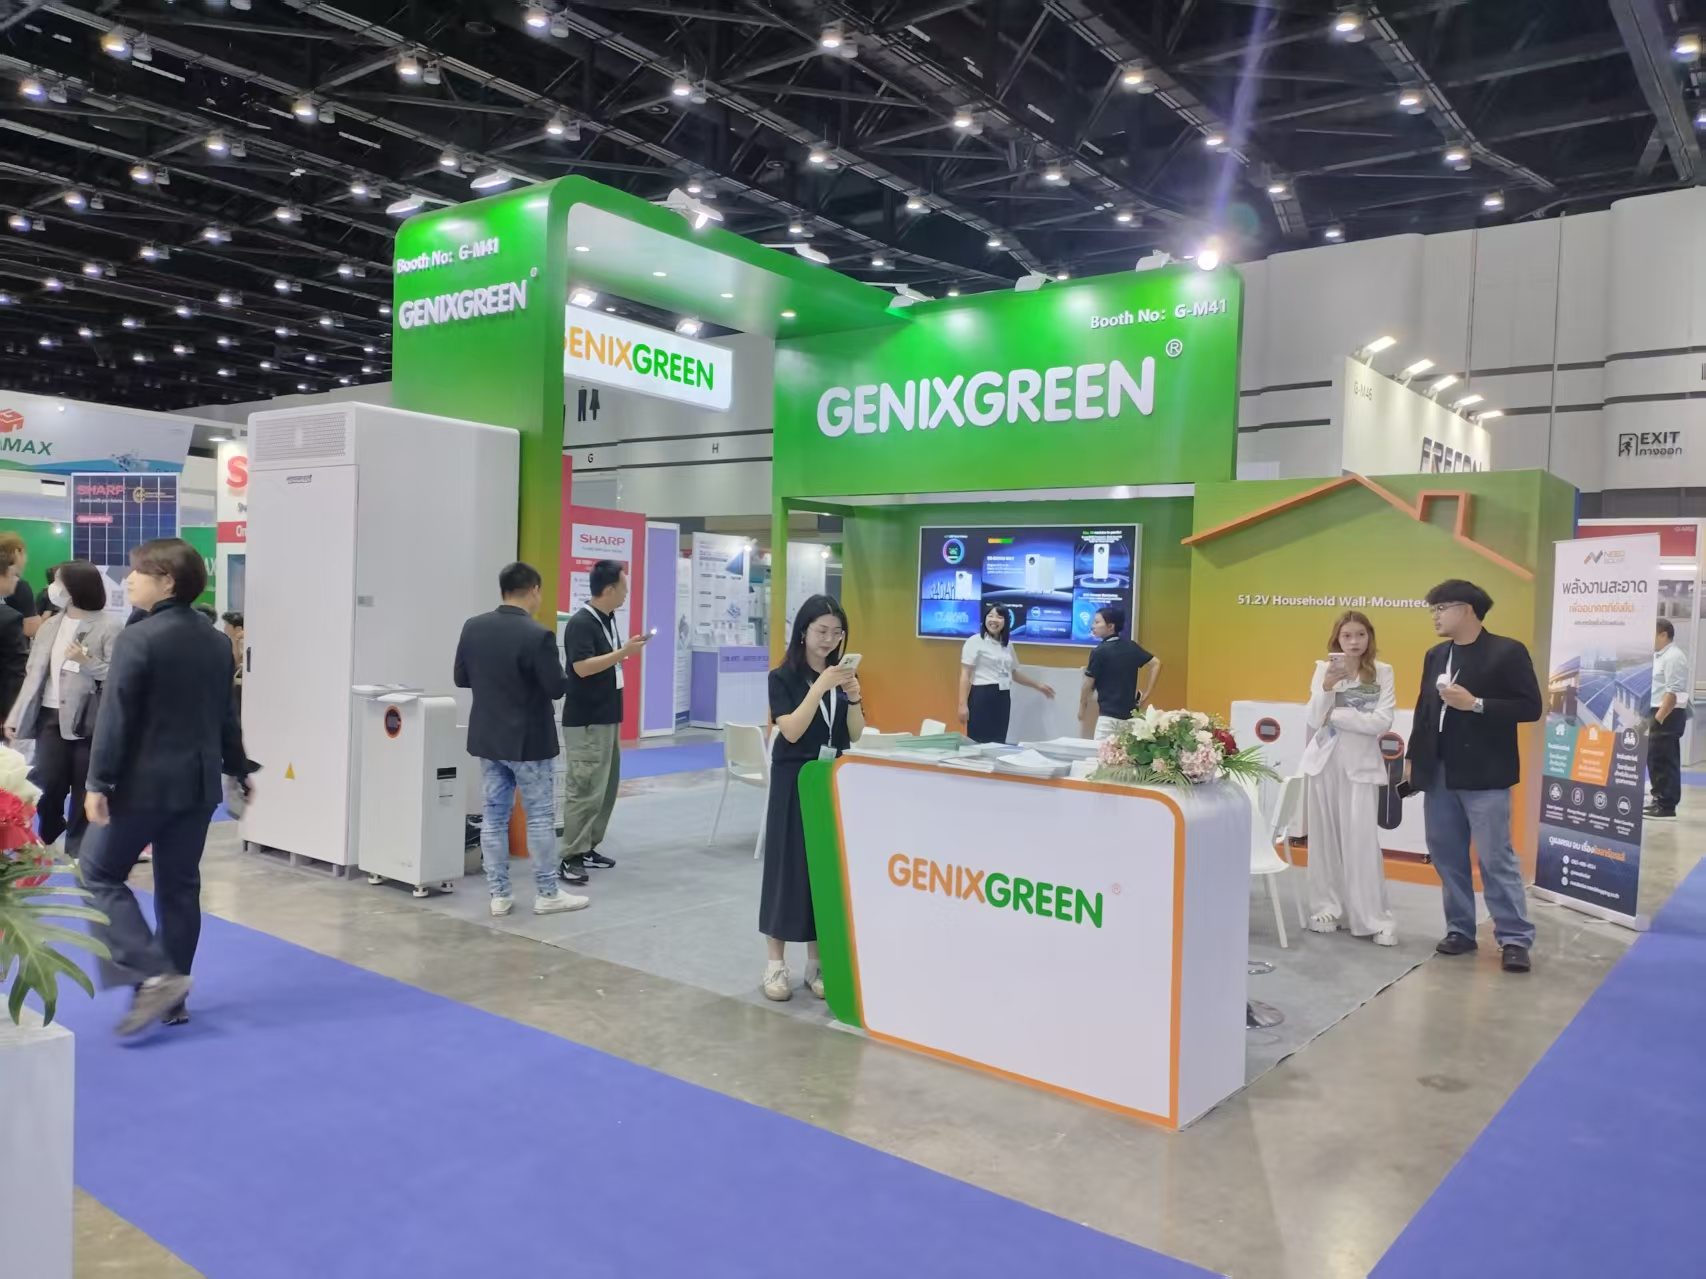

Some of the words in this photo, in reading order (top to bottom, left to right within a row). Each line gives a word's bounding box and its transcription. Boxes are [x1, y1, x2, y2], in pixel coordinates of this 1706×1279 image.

[397, 252, 430, 273] Booth
[432, 249, 453, 266] No:
[459, 237, 499, 260] G-M41
[399, 279, 527, 329] GENIXGREEN
[1091, 310, 1134, 329] Booth
[1138, 308, 1166, 323] No:
[1174, 299, 1226, 319] G-M41
[564, 326, 714, 391] ENIXGREEN
[817, 356, 1156, 437] GENIXGREEN
[0, 437, 53, 456] MAX
[1640, 431, 1681, 445] EXIT
[712, 443, 719, 453] H
[76, 484, 125, 496] SHARP
[579, 533, 626, 547] SHARP
[1562, 577, 1648, 595] พลังงานสะอาด
[1238, 594, 1269, 605] 51.2V
[1273, 595, 1335, 607] Household
[888, 853, 1103, 928] GENIXGREEN
